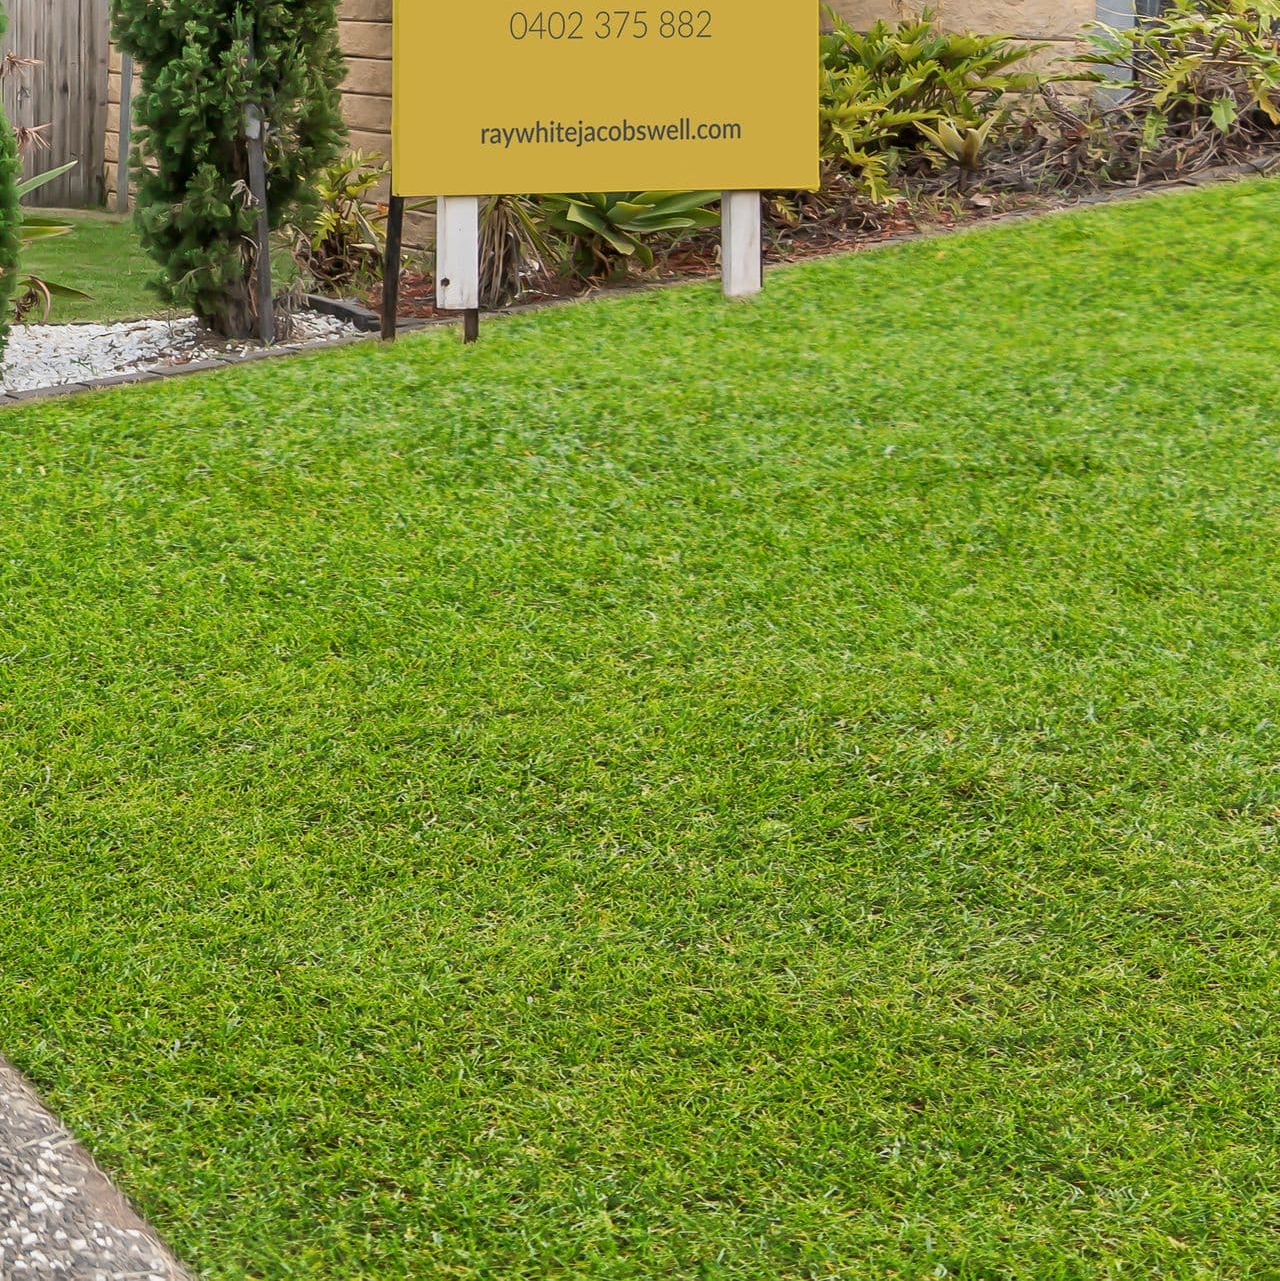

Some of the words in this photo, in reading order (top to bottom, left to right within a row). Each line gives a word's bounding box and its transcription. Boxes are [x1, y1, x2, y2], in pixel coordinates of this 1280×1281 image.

[510, 11, 583, 40] 0402
[595, 11, 647, 39] 375
[660, 10, 712, 38] 882
[482, 118, 740, 148] raywhitejacobswell.com
